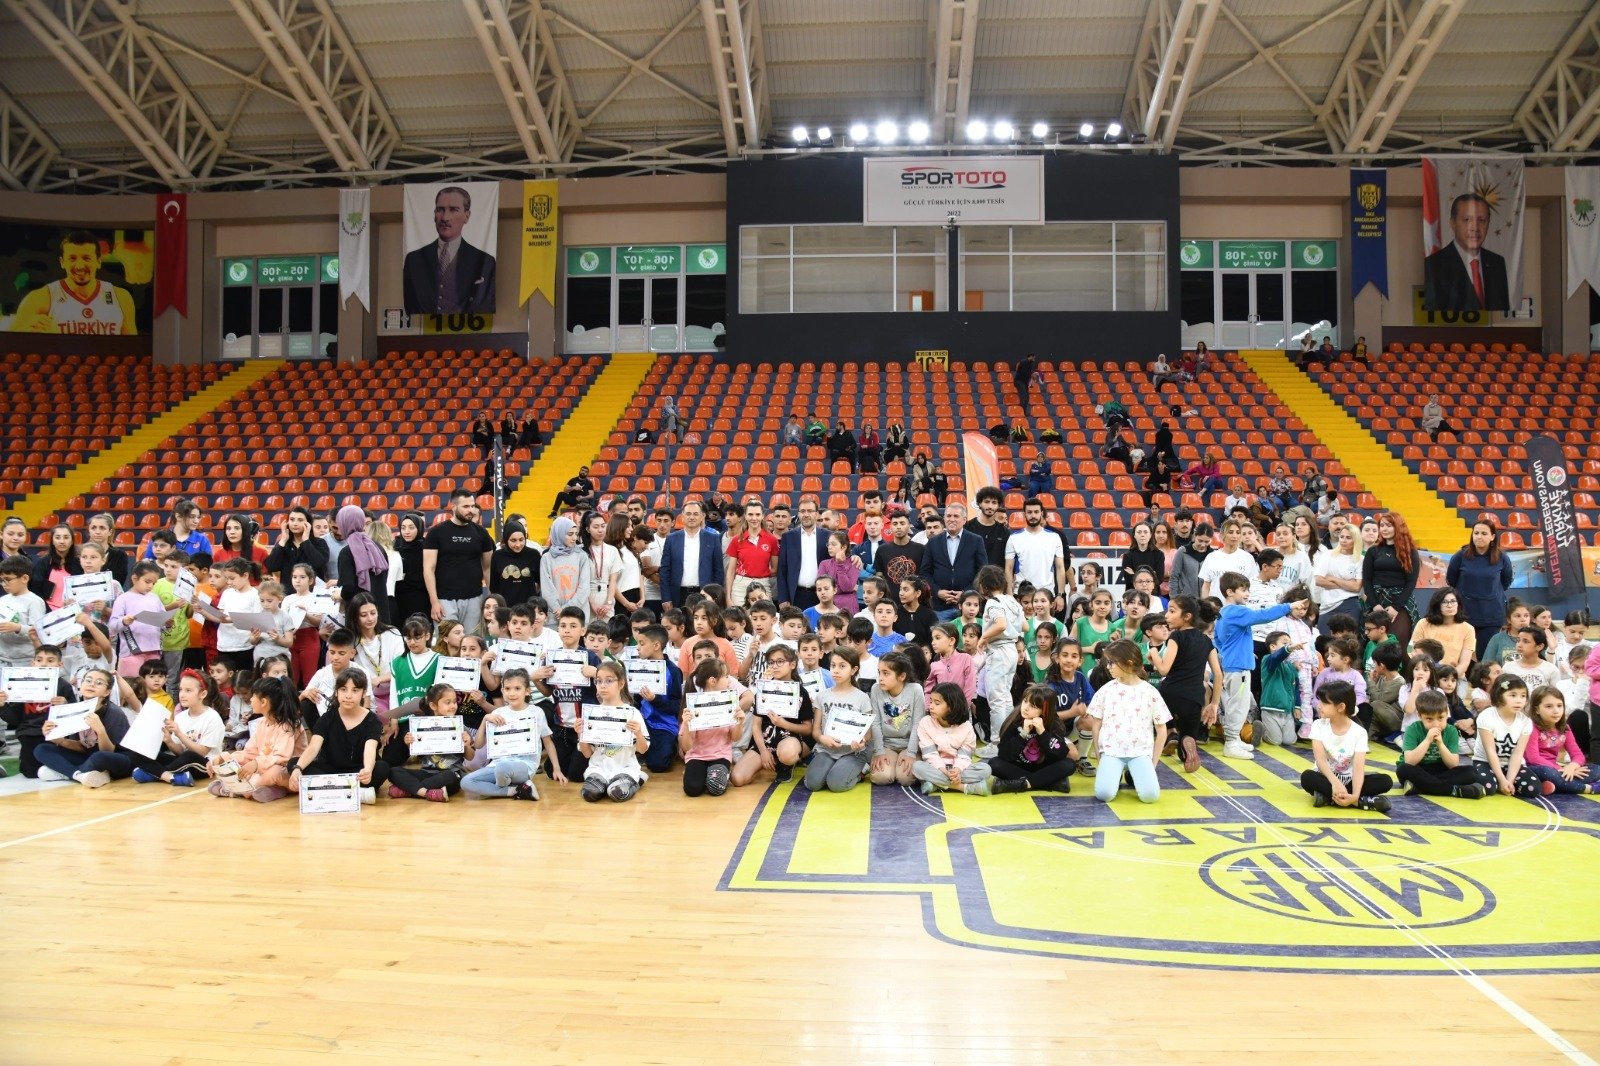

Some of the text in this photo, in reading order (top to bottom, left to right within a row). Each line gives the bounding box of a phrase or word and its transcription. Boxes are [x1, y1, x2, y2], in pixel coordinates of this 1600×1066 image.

[58, 320, 117, 335] TÜRKİYE
[429, 313, 485, 332] 106
[552, 688, 582, 698] QATAR
[1056, 694, 1068, 707] 10
[1053, 826, 1500, 849] ANKARA
